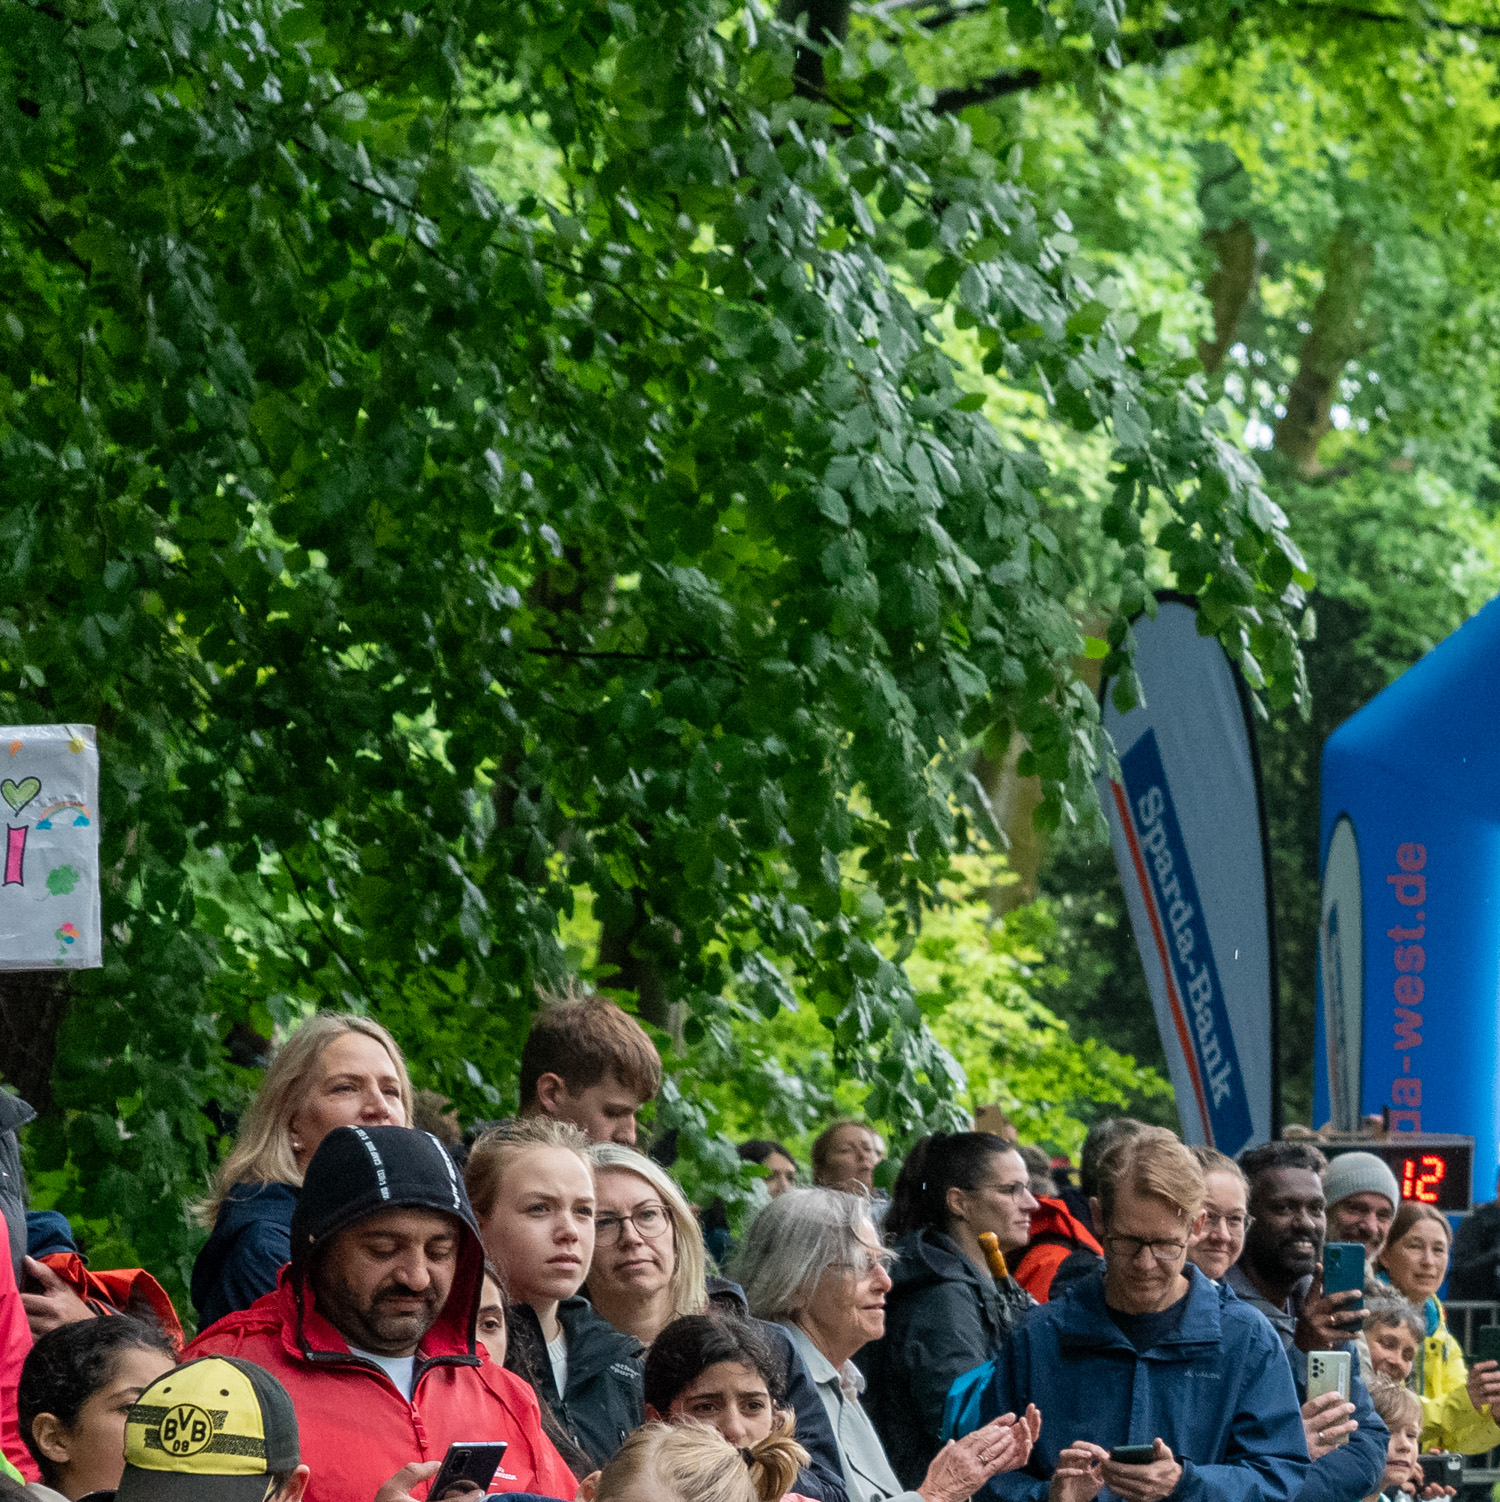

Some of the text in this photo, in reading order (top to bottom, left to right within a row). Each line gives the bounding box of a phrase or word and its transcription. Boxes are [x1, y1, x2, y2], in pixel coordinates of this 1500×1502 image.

[1137, 784, 1234, 1110] Sparda-Bank
[1402, 1154, 1446, 1203] 12
[164, 1408, 208, 1442] BVB
